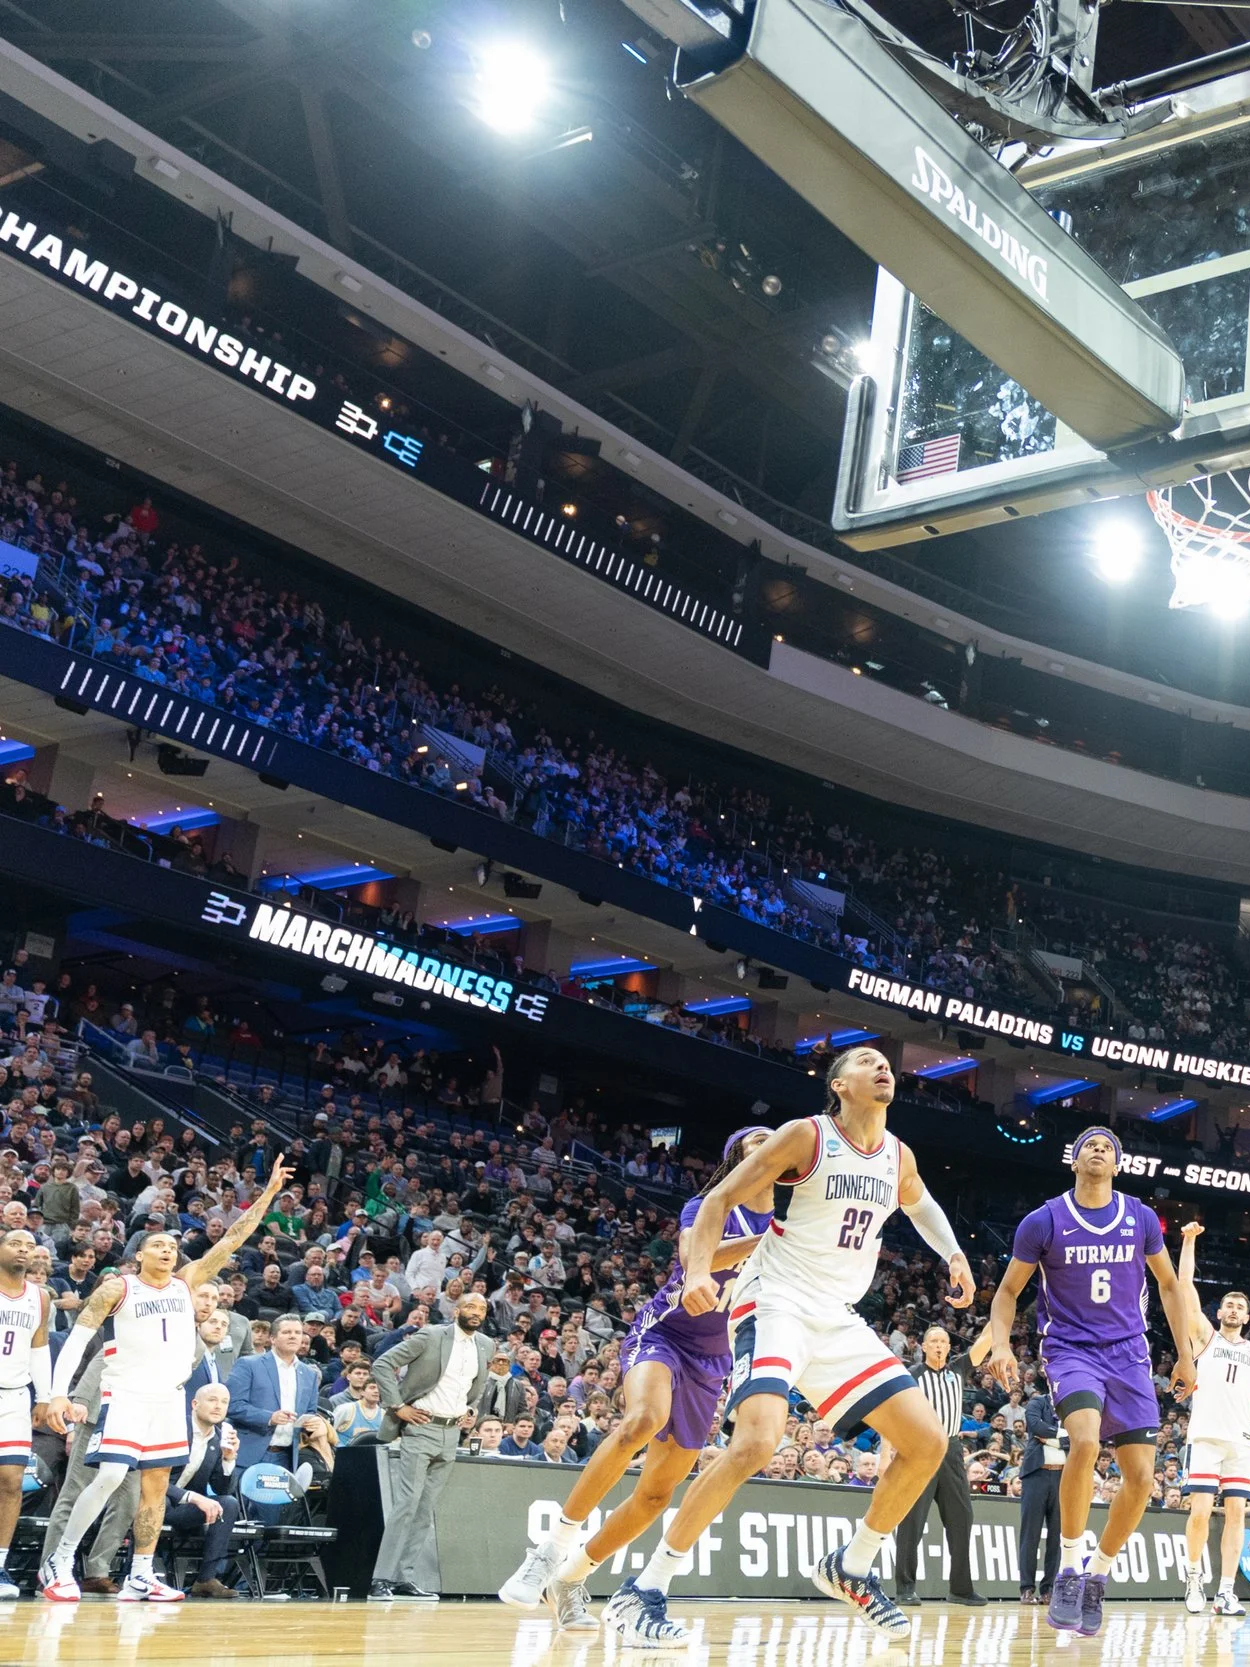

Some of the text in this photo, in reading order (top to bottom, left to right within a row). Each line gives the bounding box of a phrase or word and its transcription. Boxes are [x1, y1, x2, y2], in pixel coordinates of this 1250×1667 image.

[911, 145, 1050, 304] SPALDING
[0, 208, 317, 401] HAMPIONSHIP
[848, 969, 943, 1015] FURMAN
[945, 999, 1053, 1045] PALADINS
[1061, 1032, 1084, 1051] VS
[1091, 1037, 1169, 1070] UCONN
[1119, 1153, 1161, 1177] RST
[1163, 1167, 1181, 1176] AND
[825, 1174, 893, 1210] CONNECTICUT
[838, 1208, 873, 1250] 23
[1065, 1245, 1135, 1264] FURMAN
[1090, 1269, 1111, 1304] 6
[134, 1298, 186, 1319] CONNECTICUT
[3, 1331, 15, 1356] 9
[161, 1318, 168, 1342] 1
[1226, 1363, 1238, 1384] 11
